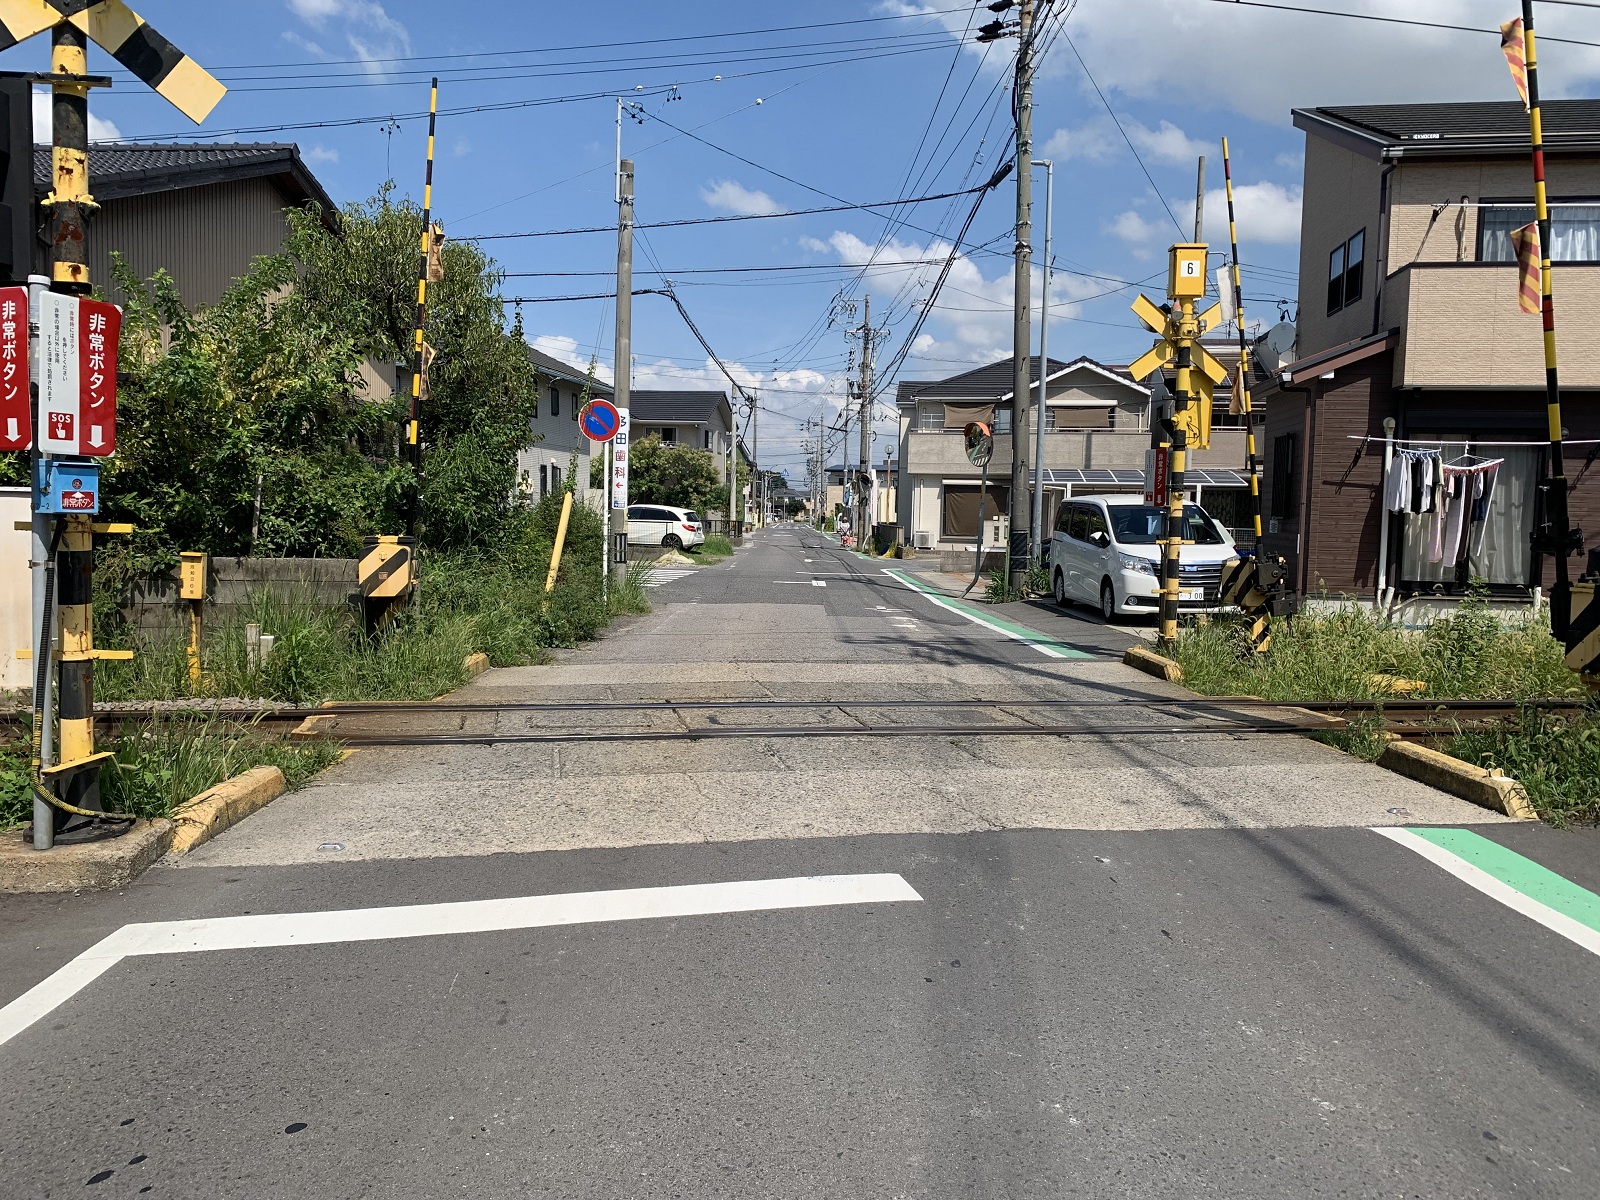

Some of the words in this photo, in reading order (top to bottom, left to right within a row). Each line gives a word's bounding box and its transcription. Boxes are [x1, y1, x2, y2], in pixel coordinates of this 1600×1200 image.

[1187, 262, 1193, 274] 6
[2, 300, 18, 400] 非常ボタン
[89, 313, 107, 408] 非常ボタン
[51, 413, 71, 423] SOS
[62, 498, 94, 508] 非常ボタン
